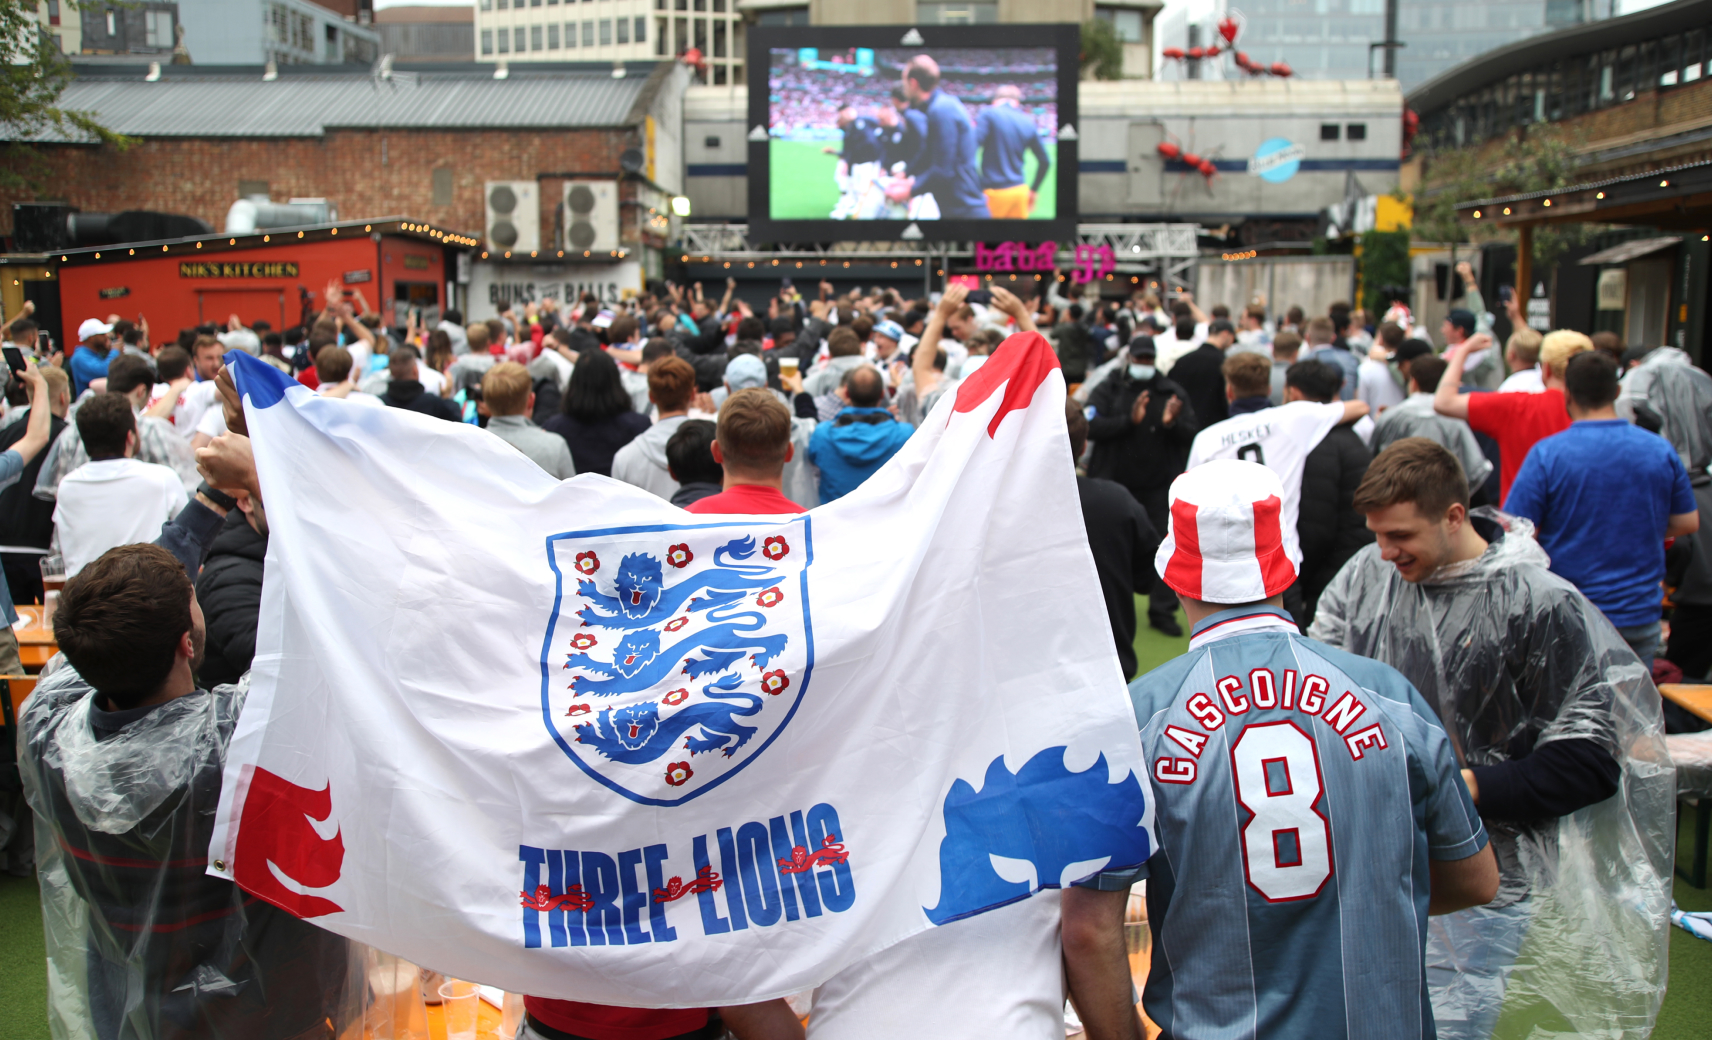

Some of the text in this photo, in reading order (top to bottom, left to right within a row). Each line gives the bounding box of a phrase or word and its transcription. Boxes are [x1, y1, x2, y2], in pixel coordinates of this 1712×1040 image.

[180, 261, 298, 278] NIK'S KITCHEN
[976, 240, 1056, 271] baba
[489, 282, 536, 304] BUNS
[565, 282, 618, 305] BALLS
[1221, 423, 1271, 446] HESKEY
[1154, 668, 1388, 785] GASCOIGNE
[1230, 719, 1334, 903] 8
[518, 802, 857, 948] THREE LIONS
